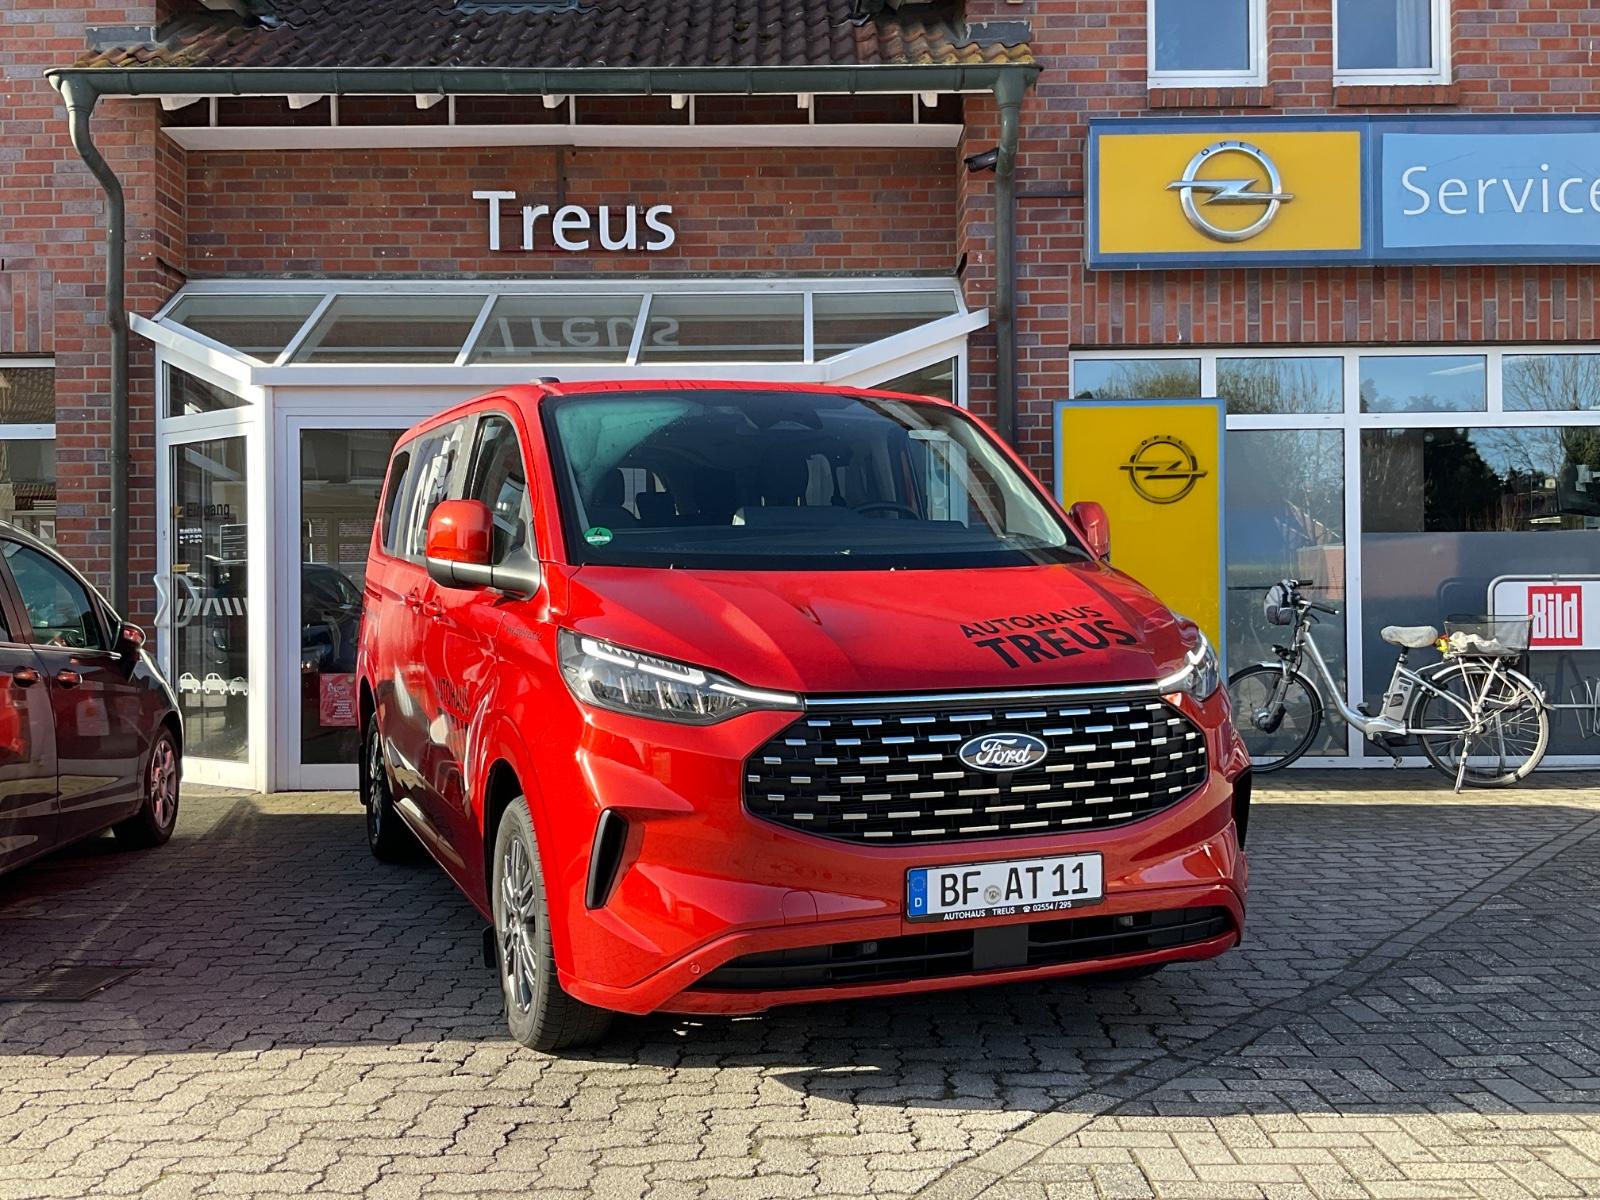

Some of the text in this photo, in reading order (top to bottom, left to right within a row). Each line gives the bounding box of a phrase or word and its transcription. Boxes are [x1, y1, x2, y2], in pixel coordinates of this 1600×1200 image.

[1200, 141, 1265, 156] OPEL
[472, 190, 676, 251] Treus
[594, 528, 602, 536] 4
[959, 606, 1103, 638] AUTOHAUS
[1532, 593, 1578, 639] Bild
[974, 619, 1138, 669] TREUS
[975, 738, 1032, 765] Ford
[940, 870, 981, 907] BF
[1004, 866, 1044, 901] AT
[914, 897, 923, 908] D
[943, 909, 986, 920] AUTOHAUS
[992, 906, 1015, 916] TREUS
